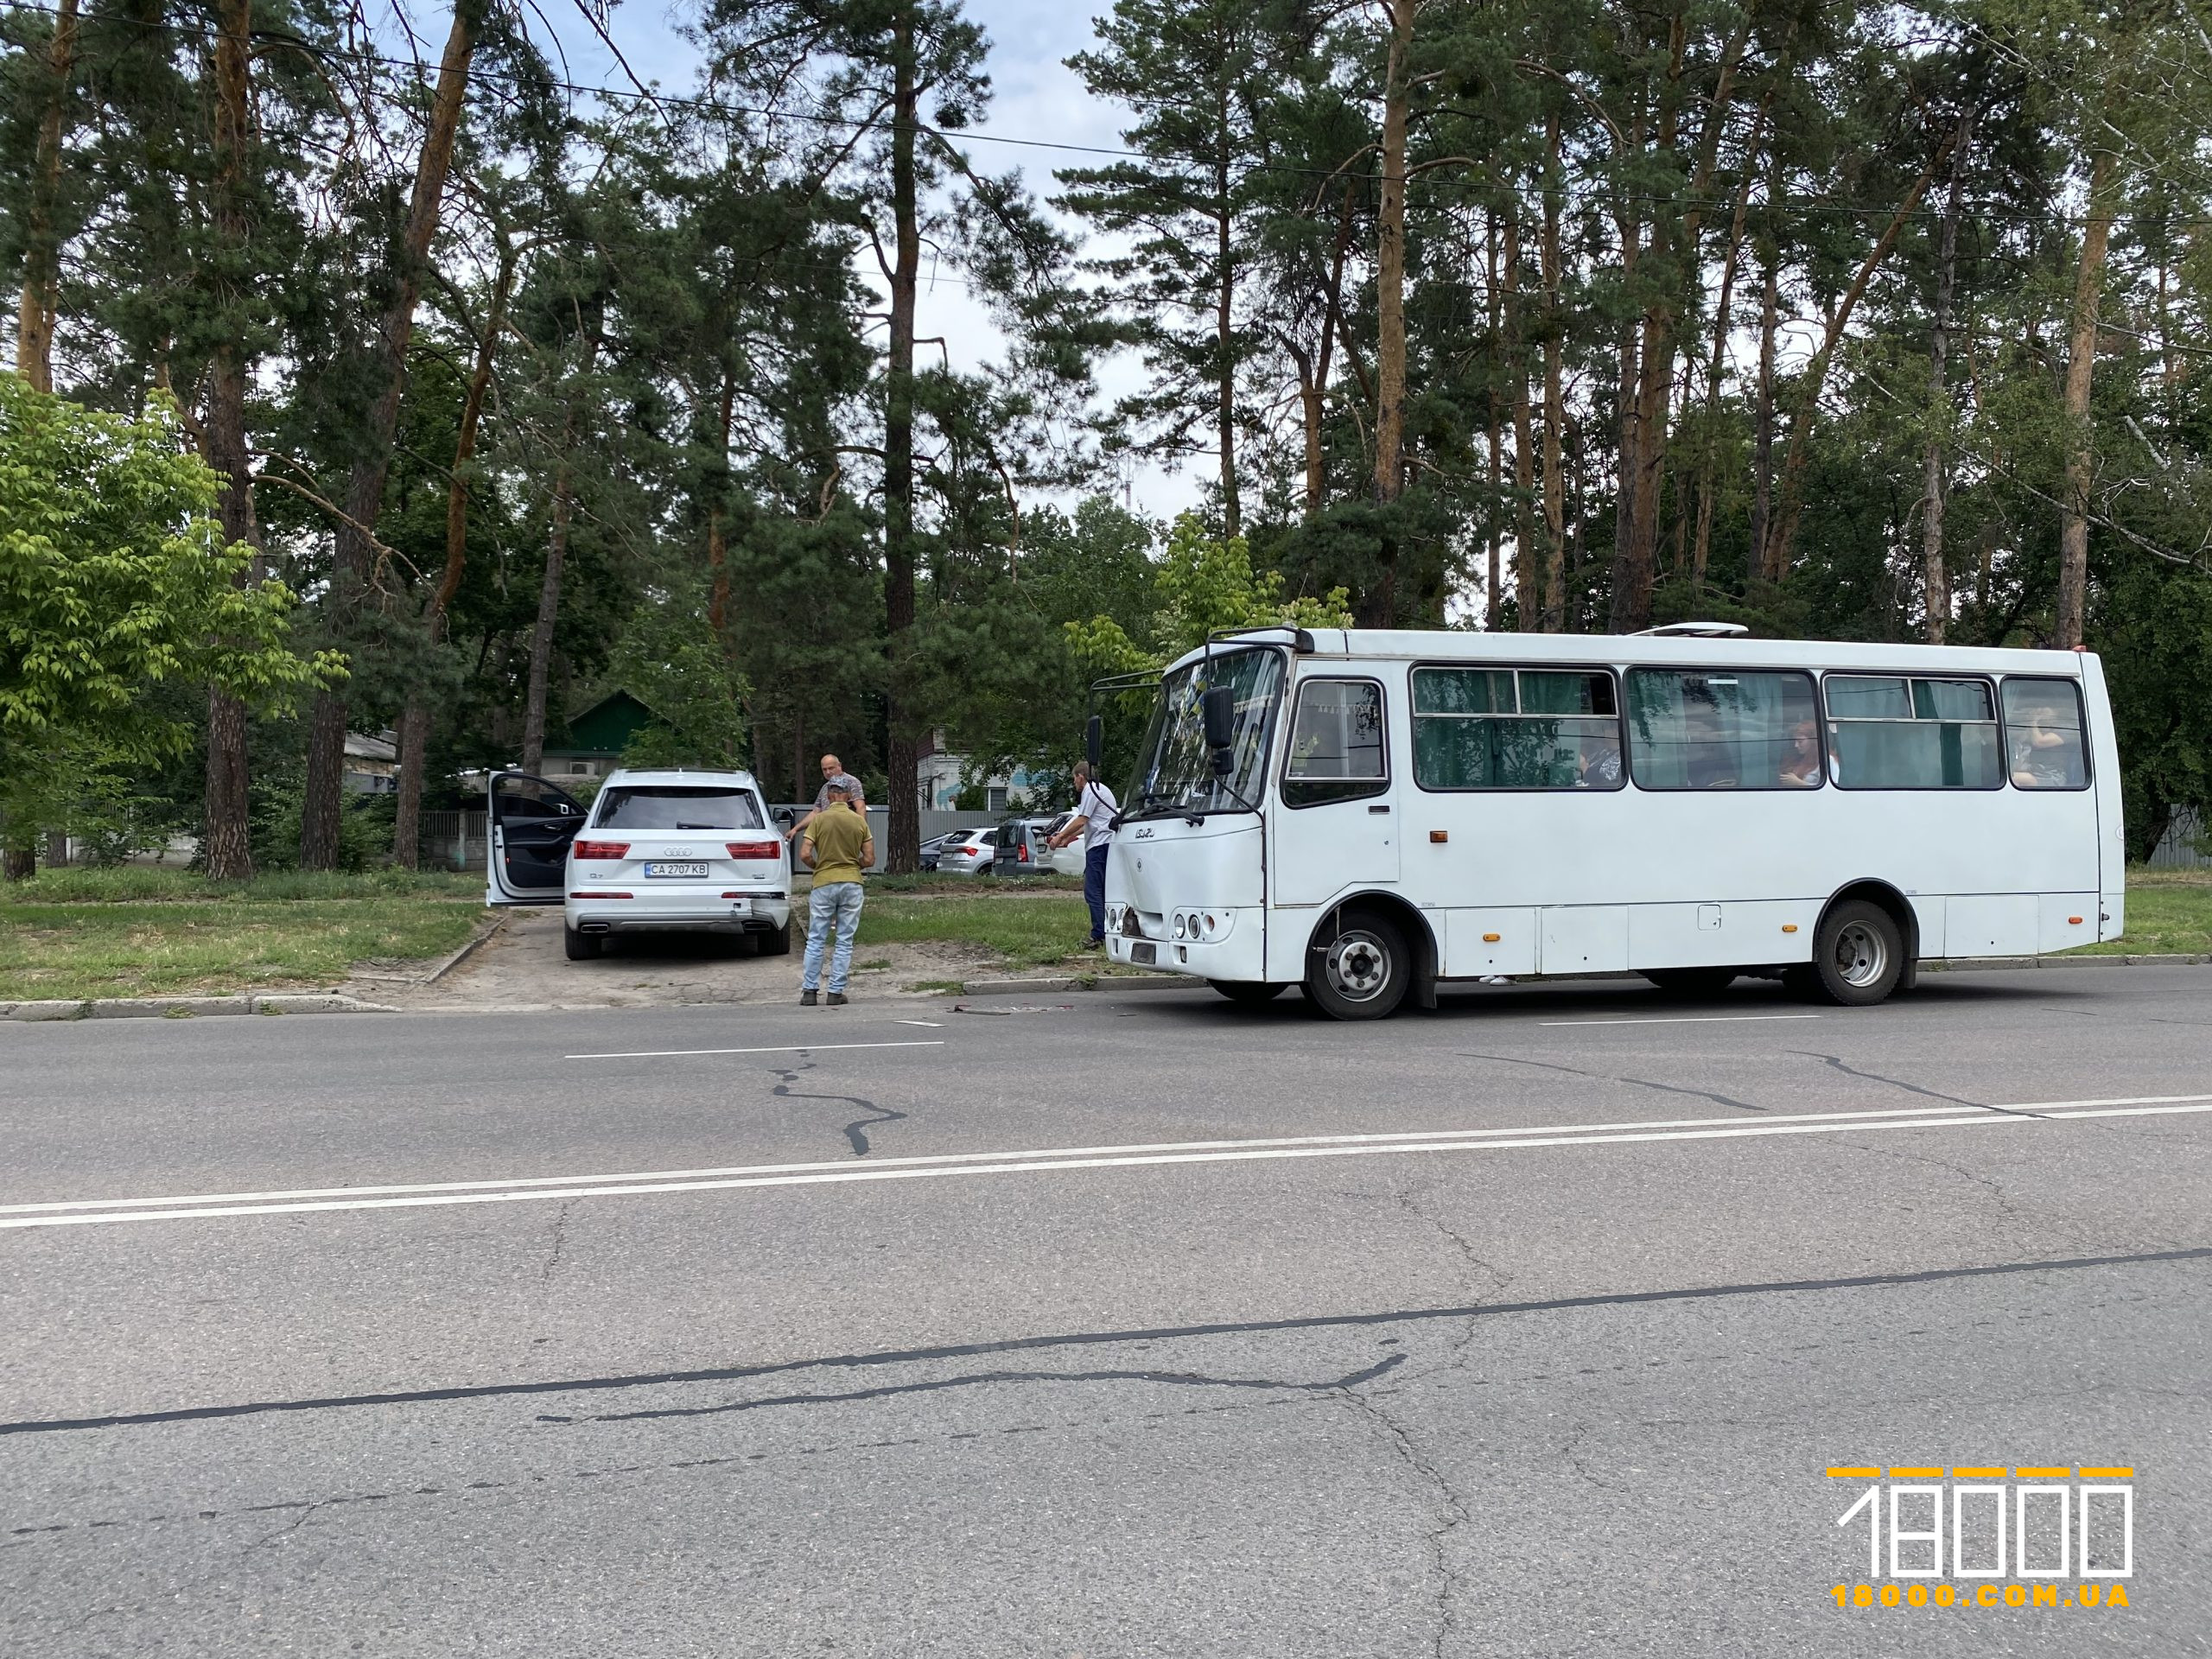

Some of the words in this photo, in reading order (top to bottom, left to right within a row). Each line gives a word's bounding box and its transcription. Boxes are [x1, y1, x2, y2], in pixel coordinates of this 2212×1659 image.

[651, 865, 665, 874] CA
[668, 865, 690, 874] 2707
[692, 865, 706, 874] KB
